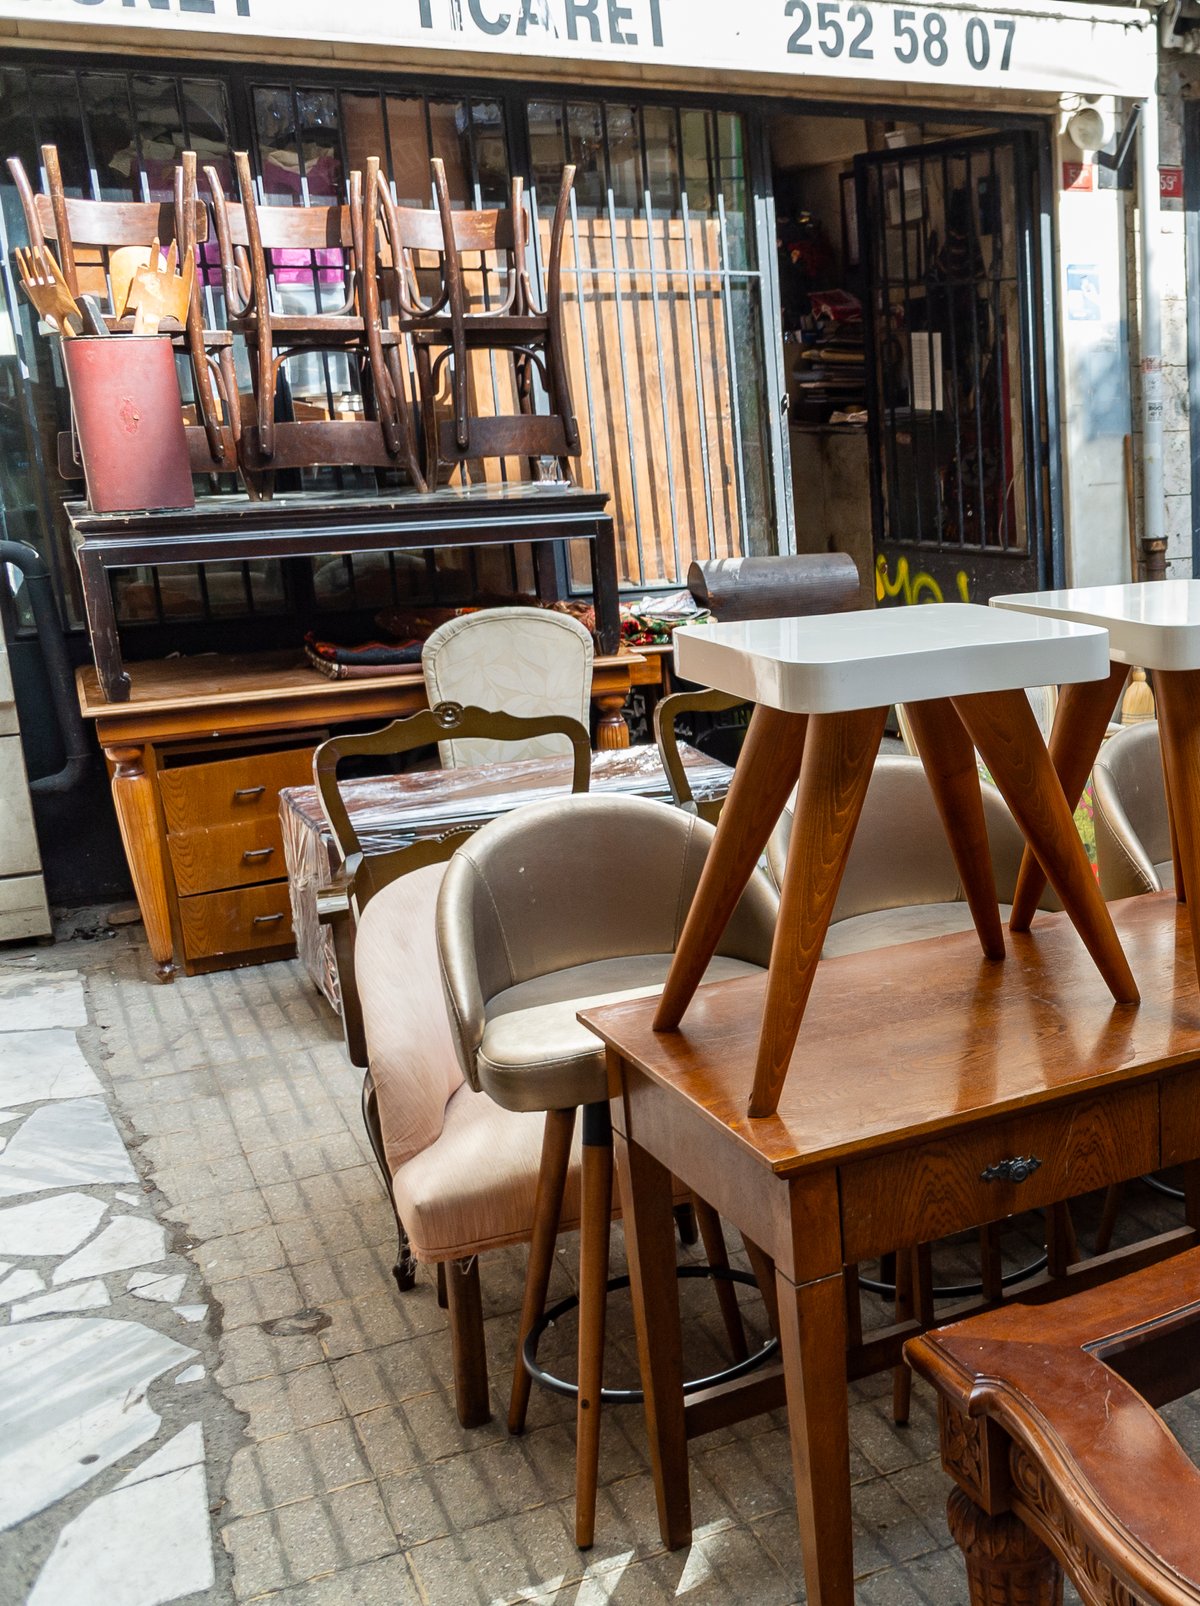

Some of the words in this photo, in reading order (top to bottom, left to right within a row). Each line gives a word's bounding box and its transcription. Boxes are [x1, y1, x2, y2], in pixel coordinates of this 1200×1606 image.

[784, 0, 874, 59] 252
[894, 9, 949, 67] 58
[966, 17, 1016, 71] 07
